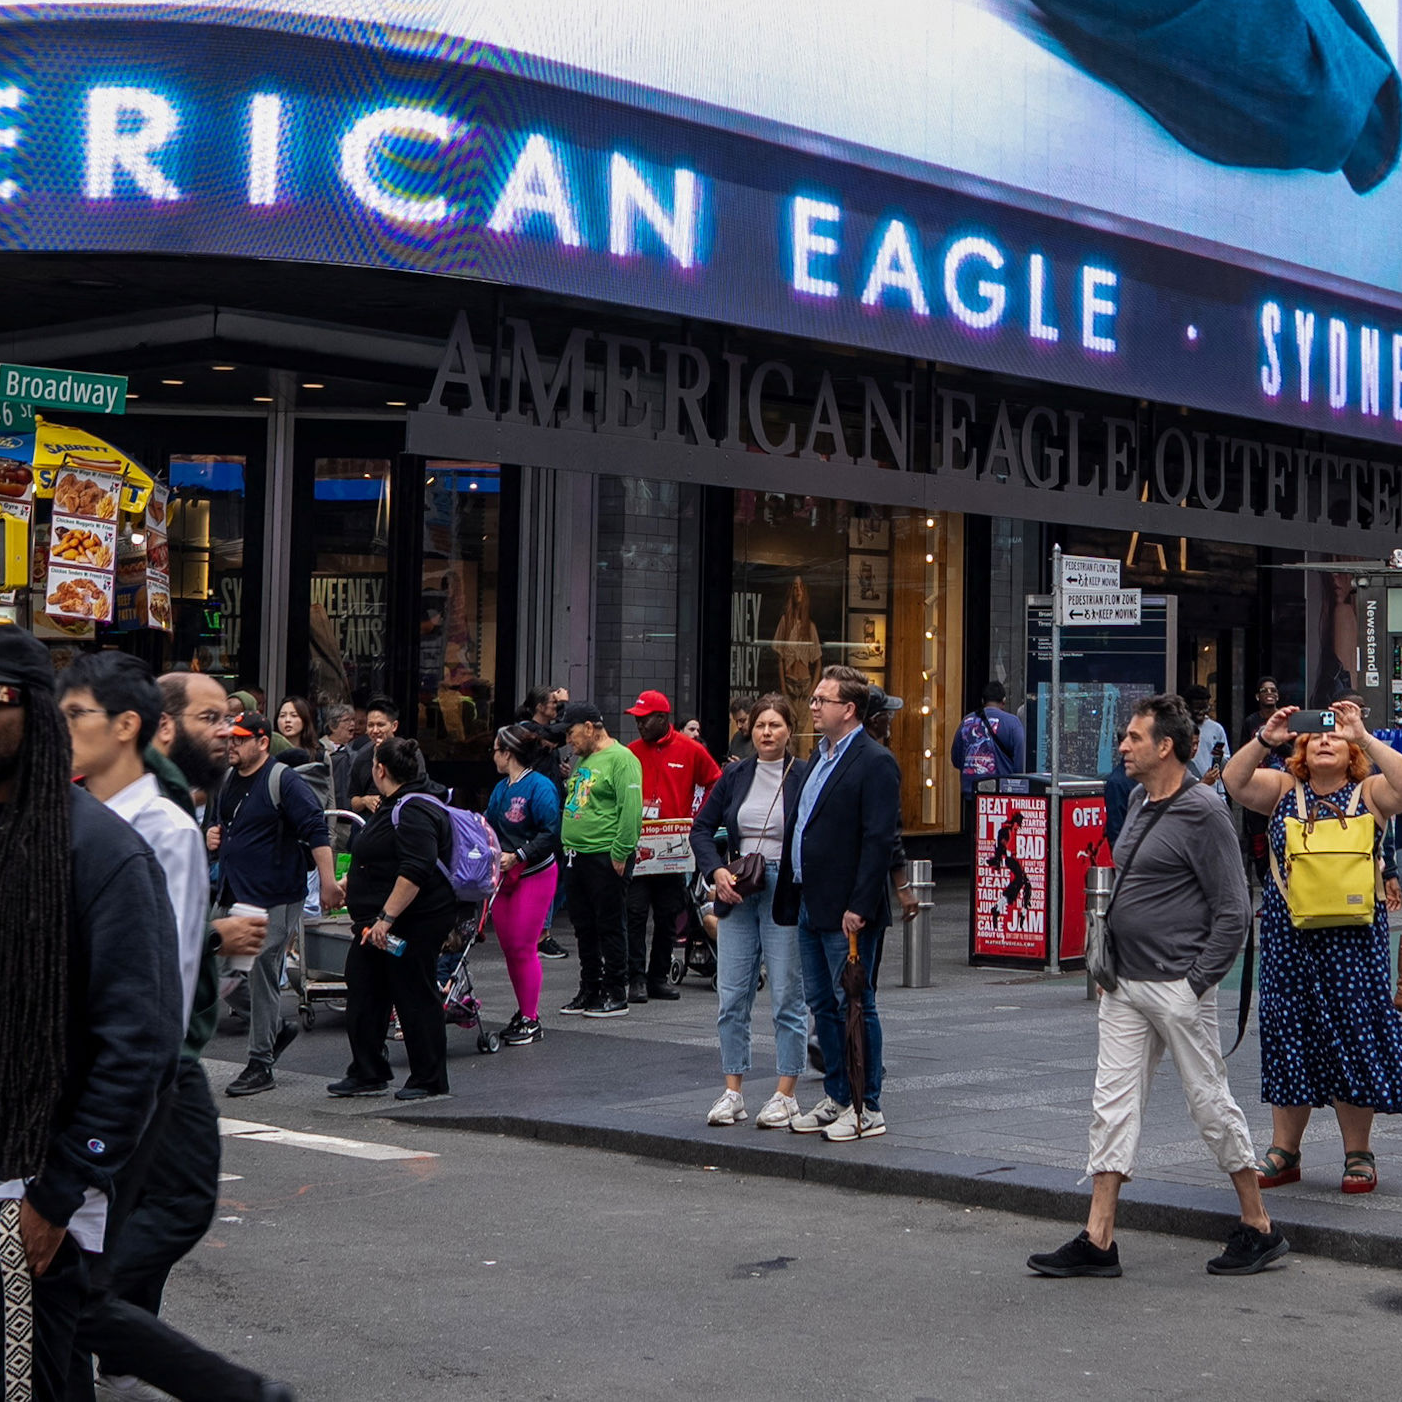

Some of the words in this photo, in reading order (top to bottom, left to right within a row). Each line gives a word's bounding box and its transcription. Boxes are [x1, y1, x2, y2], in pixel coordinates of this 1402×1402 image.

[792, 196, 1118, 353] EAGLE
[6, 371, 119, 413] Broadway
[21, 403, 33, 418] St
[418, 309, 912, 472] AMERICAN
[940, 392, 1139, 504] EAGLE
[44, 442, 110, 454] SABRETT
[3, 502, 19, 510] Gyro
[56, 516, 75, 526] Chicken
[76, 519, 95, 528] Nuggets
[102, 523, 114, 531] Fries
[51, 567, 67, 575] Chicken
[1065, 560, 1093, 571] PEDESTRIAN
[1093, 563, 1106, 573] FLOW
[1106, 564, 1118, 573] ZONE
[1089, 577, 1100, 586] KEEP
[1101, 577, 1119, 587] MOVING
[310, 577, 384, 616] WEENEY
[1068, 595, 1103, 606] PEDESTRIAN
[1104, 594, 1120, 605] FLOW
[1122, 594, 1137, 605] ZONE
[1098, 609, 1113, 619] KEEP
[1115, 608, 1138, 619] MOVING
[1366, 600, 1377, 671] Newsstand
[729, 646, 760, 687] ENEY
[978, 797, 1009, 815] BEAT
[1011, 798, 1046, 810] THRILLER
[1039, 811, 1046, 820] BE
[1072, 807, 1103, 827] OFF.
[646, 824, 674, 836] Hop-Off
[978, 815, 1008, 841] IT
[1021, 819, 1047, 828] STARTIN'
[1016, 835, 1045, 860] BAD
[978, 867, 1011, 878] BILLIE
[1025, 866, 1045, 874] BACK
[977, 877, 1011, 888] JEAN
[977, 888, 1004, 901] TABLO
